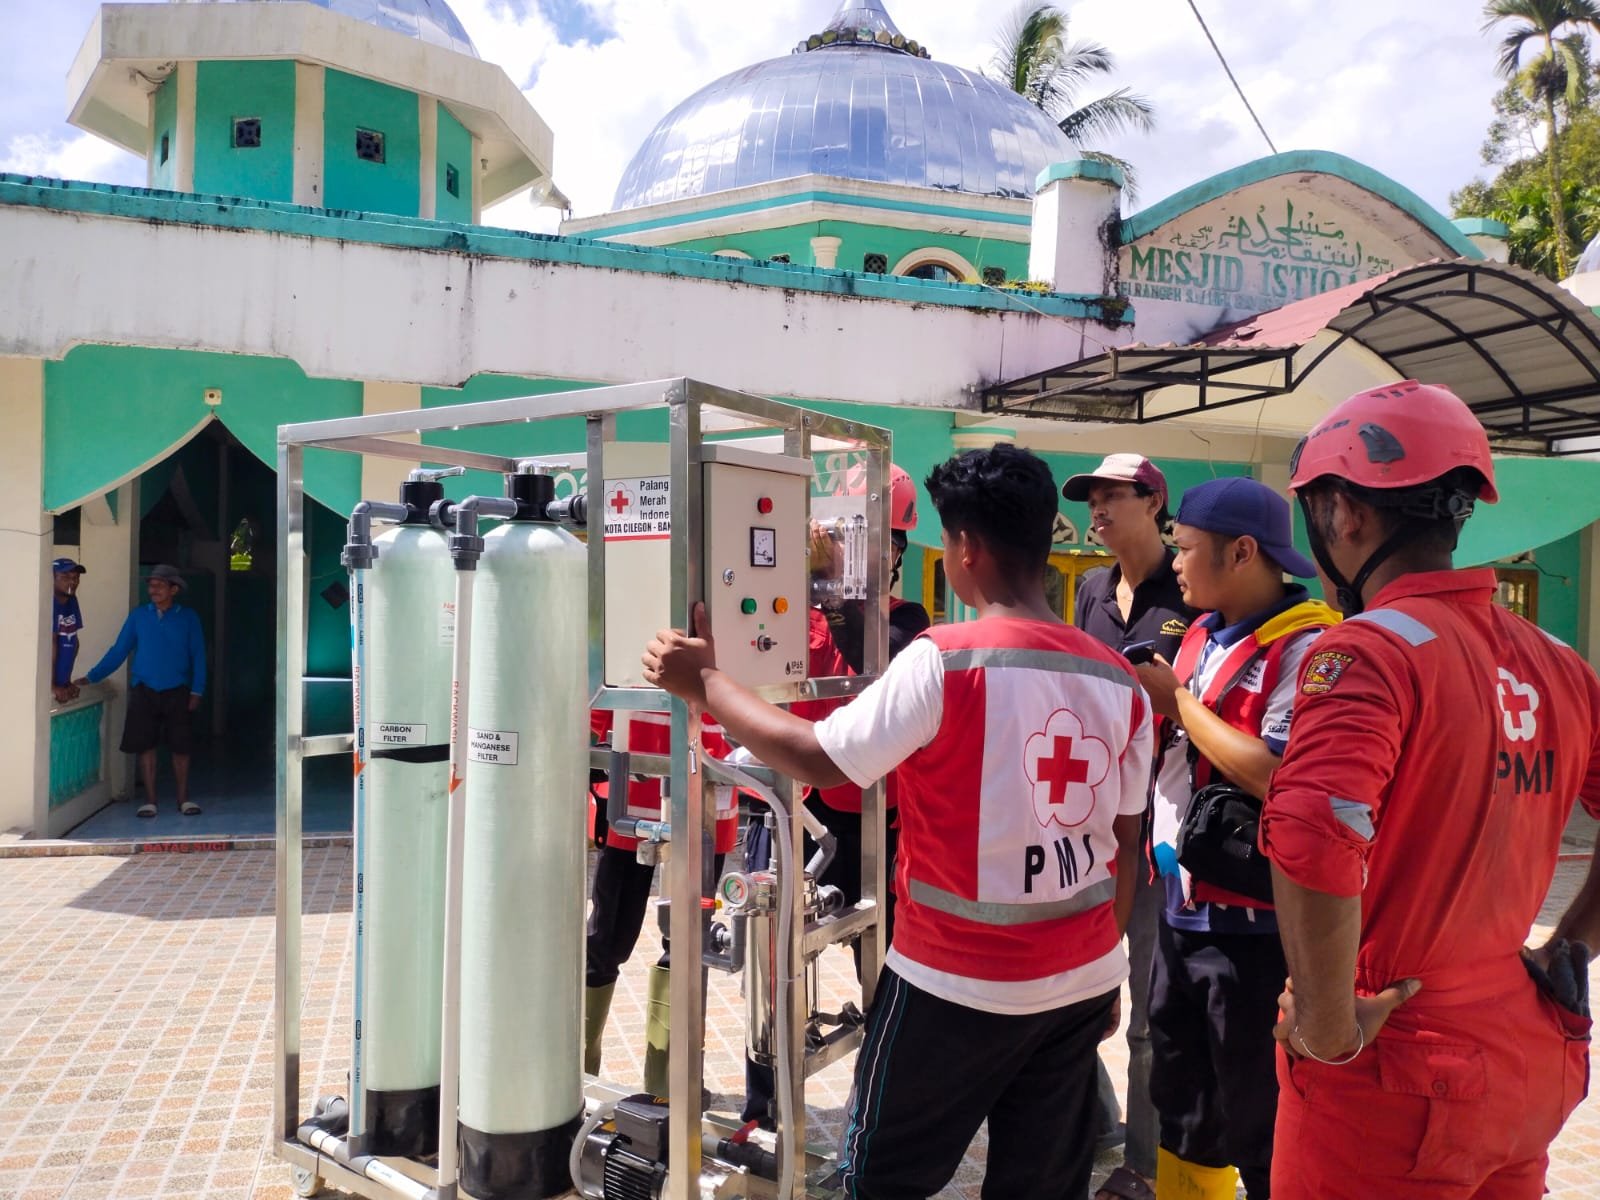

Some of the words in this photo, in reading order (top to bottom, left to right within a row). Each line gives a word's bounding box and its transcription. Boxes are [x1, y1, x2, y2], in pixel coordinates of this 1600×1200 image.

[1129, 245, 1243, 292] MESJID
[640, 480, 669, 491] Palang
[640, 495, 667, 506] Merah
[604, 524, 622, 533] KOTA
[624, 522, 652, 533] CILEGON
[380, 725, 412, 733] CARBON
[476, 732, 494, 740] SAND
[471, 740, 511, 751] MANGANESE
[477, 753, 498, 761] FILTER
[1494, 750, 1555, 795] PMI
